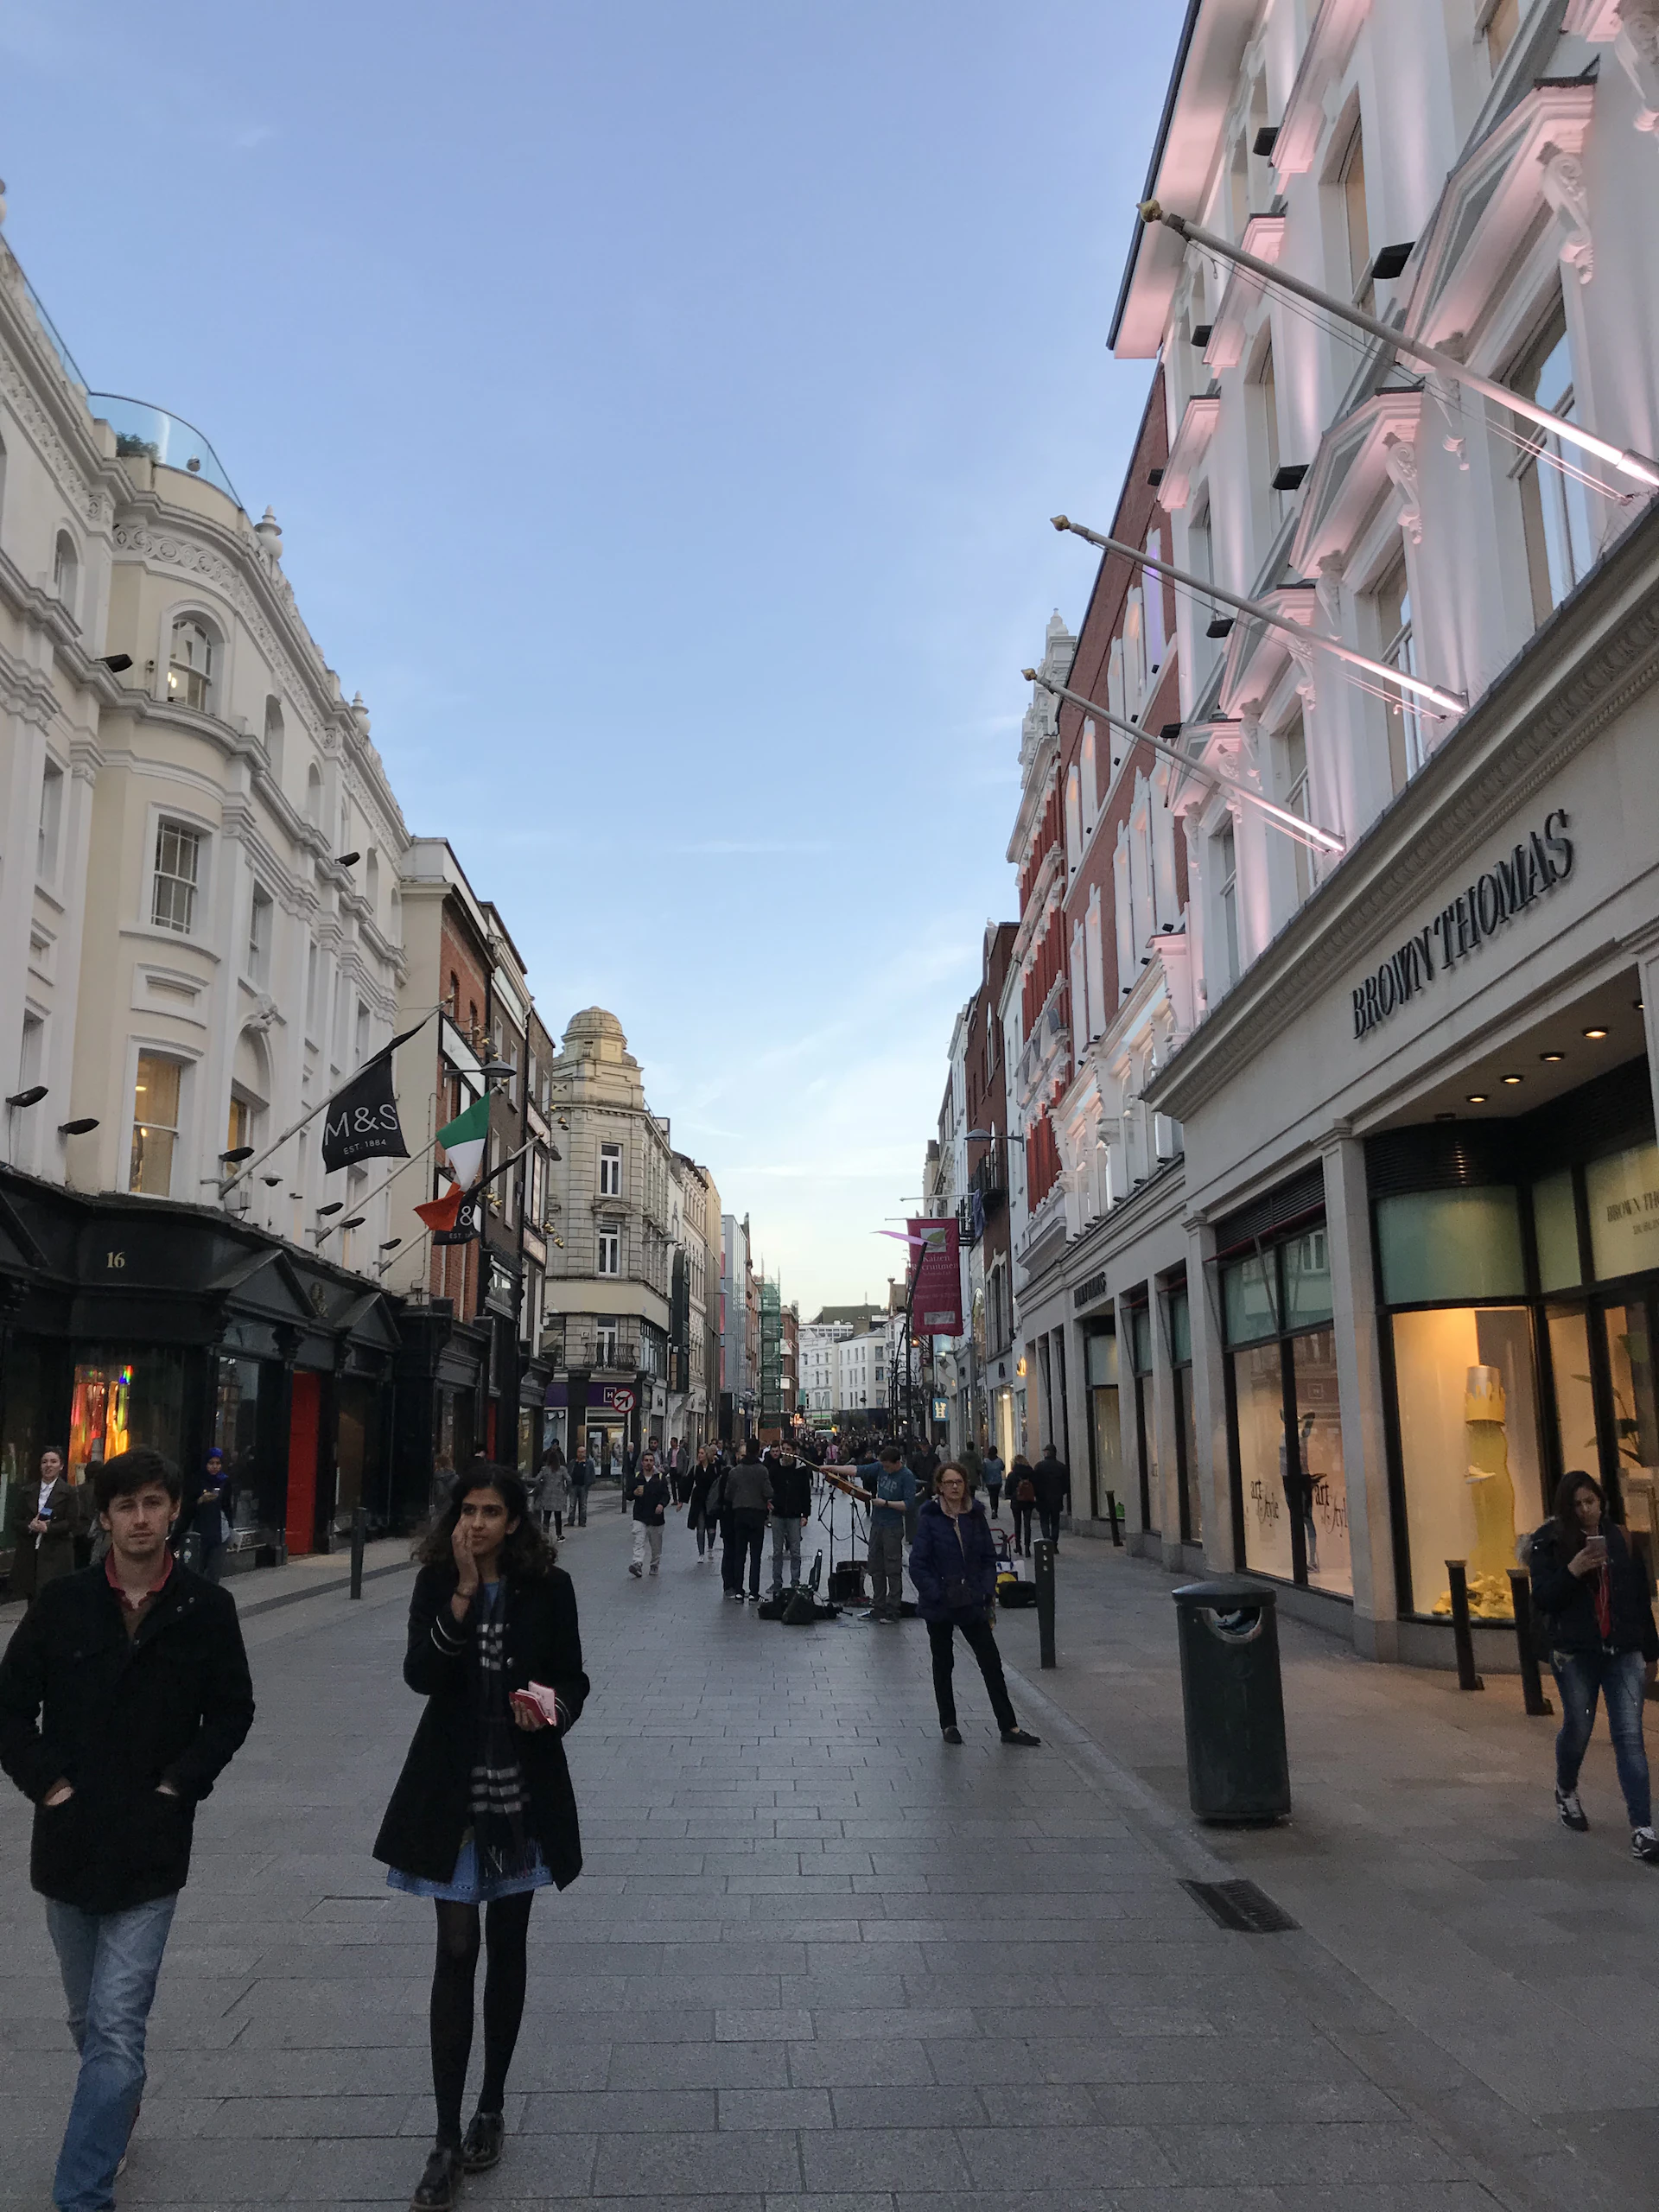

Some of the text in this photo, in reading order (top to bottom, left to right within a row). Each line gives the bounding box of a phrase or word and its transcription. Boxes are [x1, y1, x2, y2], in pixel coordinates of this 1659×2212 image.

[1352, 809, 1573, 1039] BROWN THOMAS
[324, 1103, 398, 1146] M&S
[365, 1138, 386, 1148] 1884
[107, 1251, 125, 1268] 16
[923, 1254, 950, 1262] Kaizen
